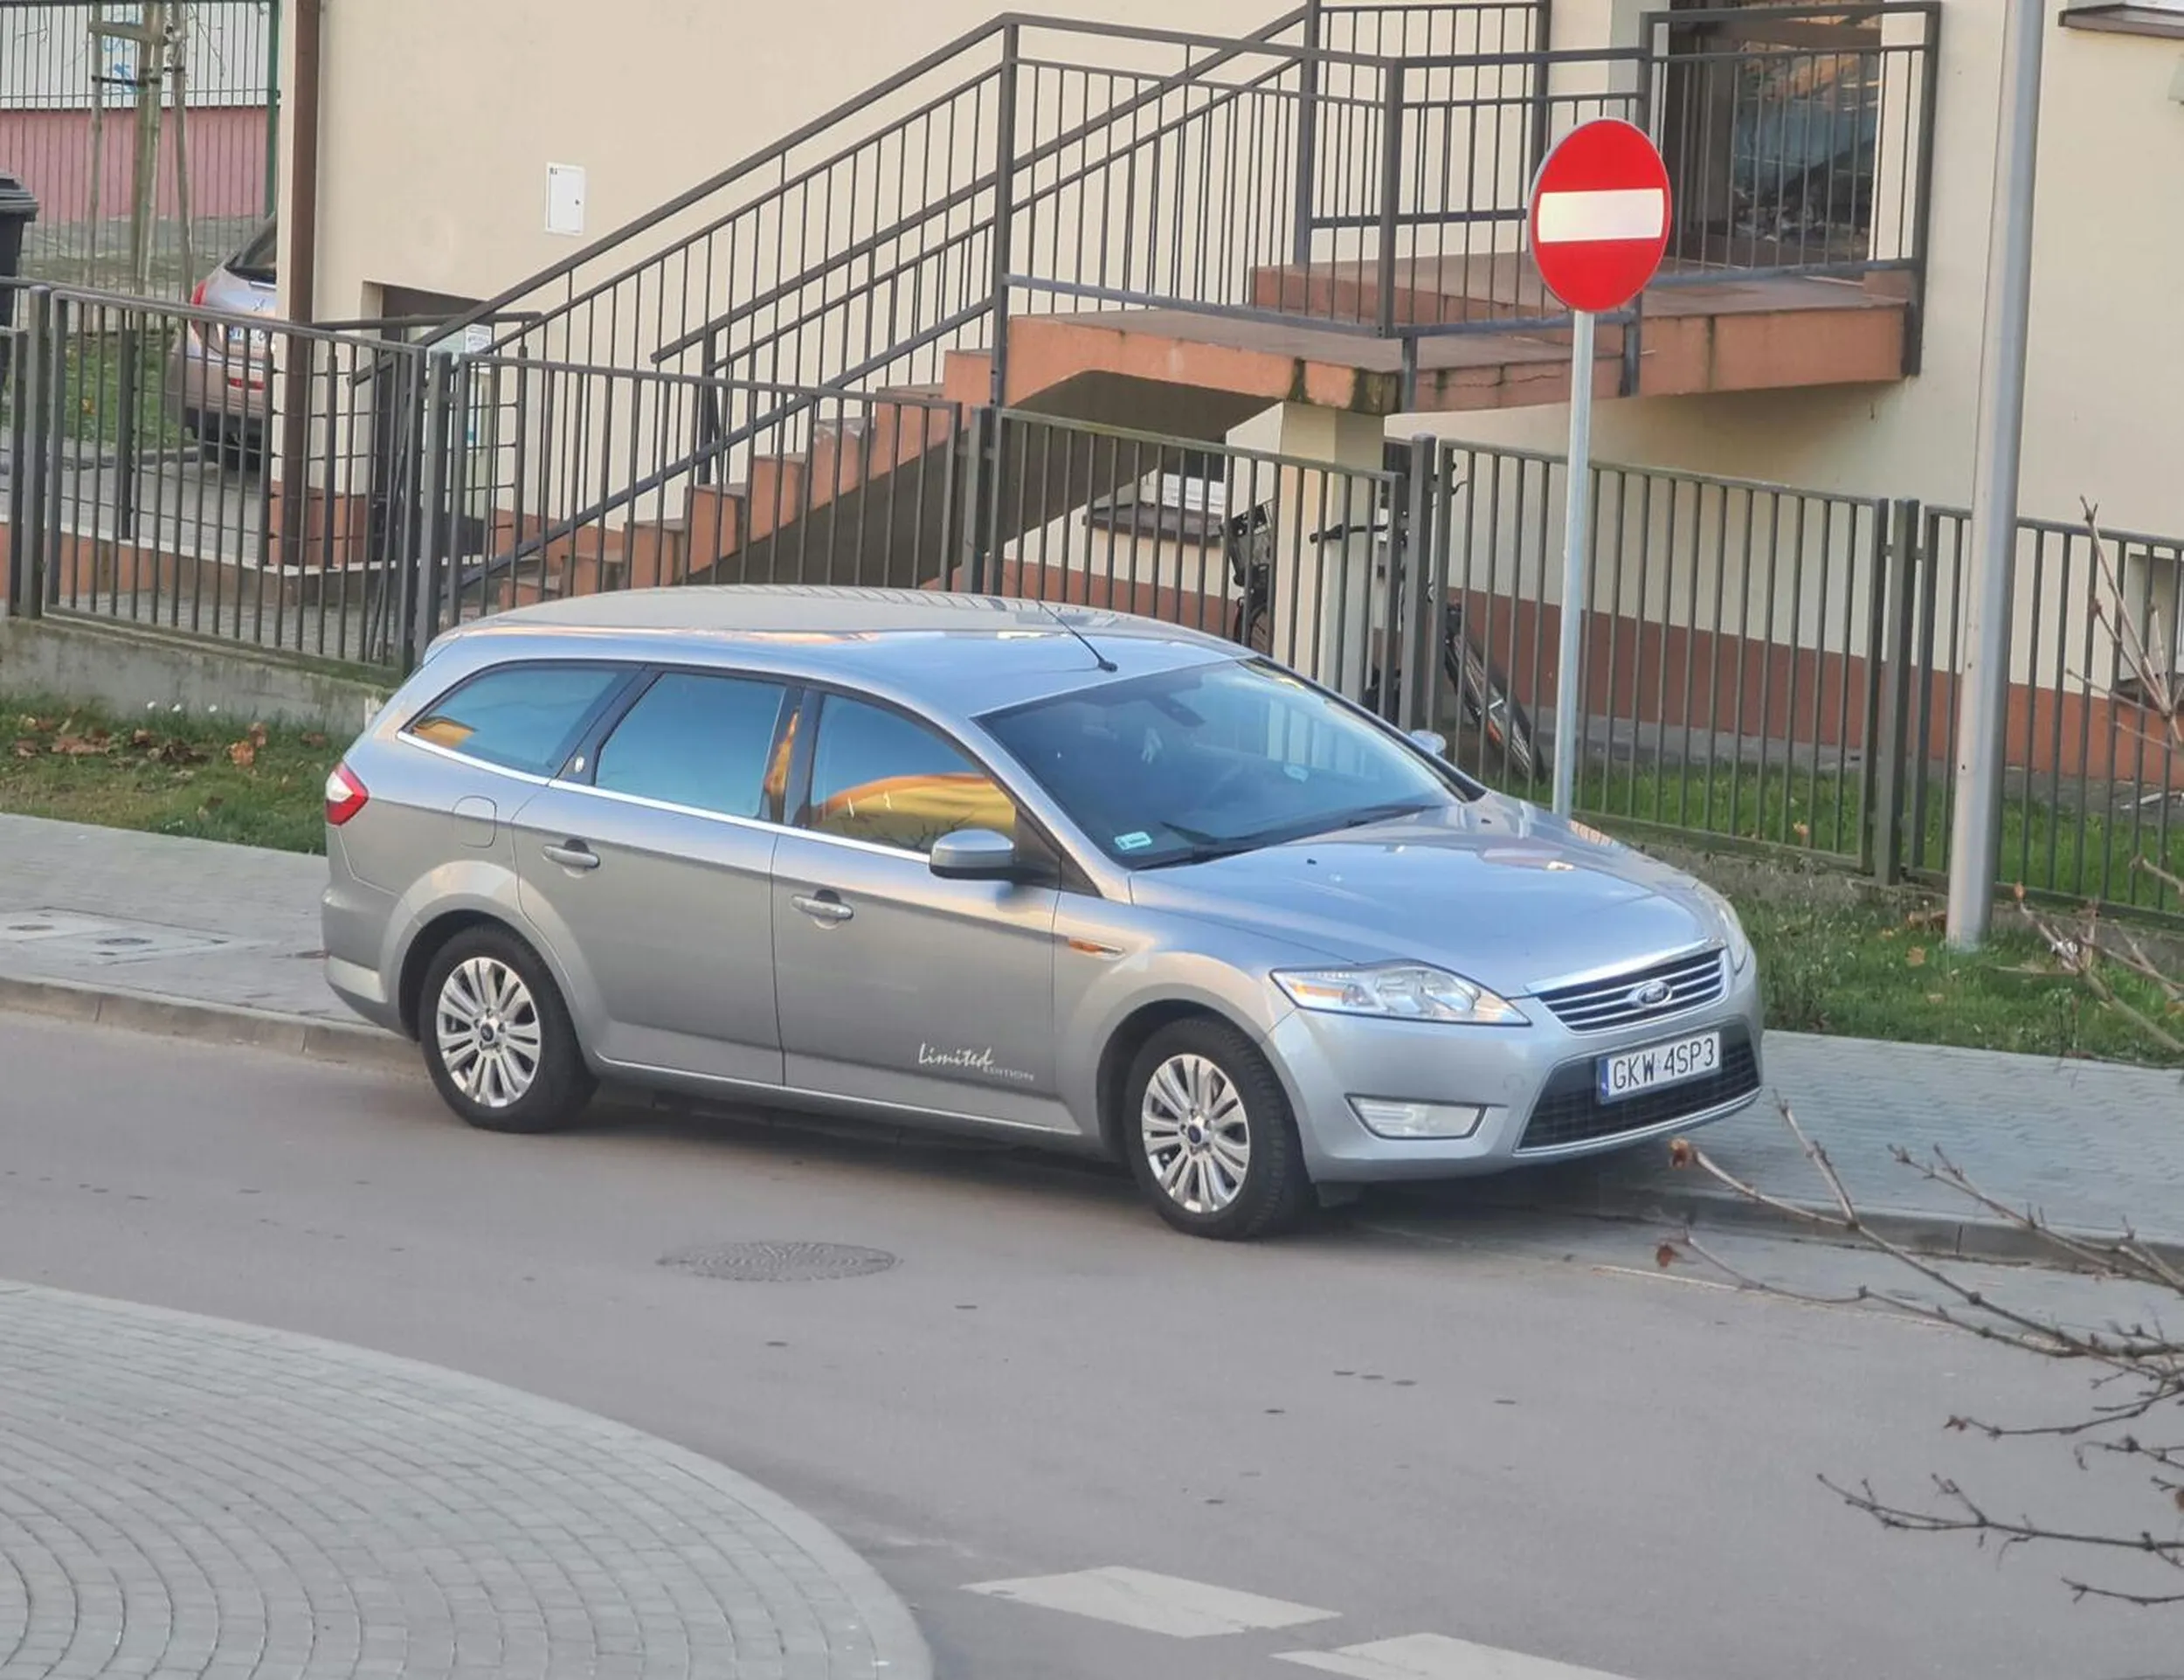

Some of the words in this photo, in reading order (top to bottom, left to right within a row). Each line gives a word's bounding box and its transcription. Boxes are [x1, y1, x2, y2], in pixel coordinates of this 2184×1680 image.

[918, 1041, 994, 1067] Limited
[1614, 1053, 1655, 1089] GKW
[1663, 1038, 1715, 1076] 4SP3
